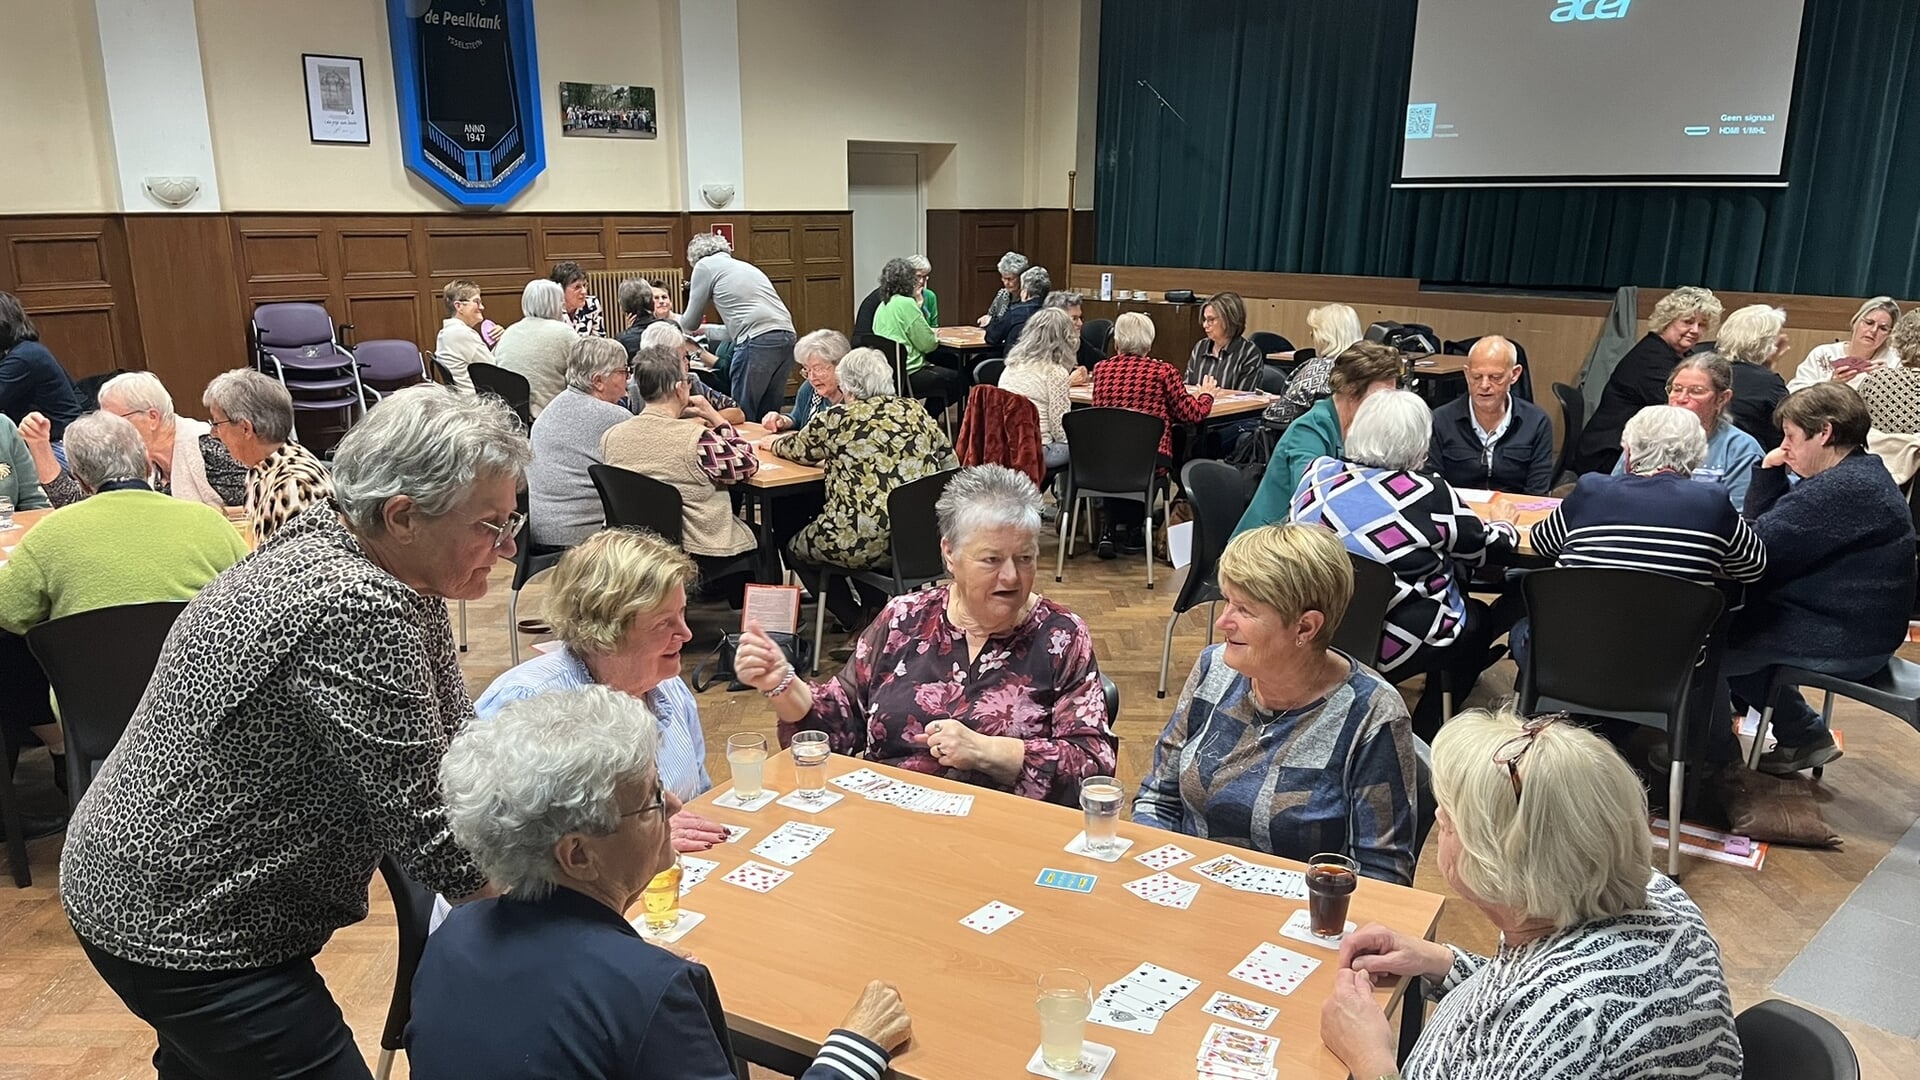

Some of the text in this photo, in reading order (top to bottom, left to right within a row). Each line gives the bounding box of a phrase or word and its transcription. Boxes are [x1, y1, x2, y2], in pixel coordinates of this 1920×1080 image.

[1550, 0, 1632, 22] acer
[424, 9, 501, 30] de Peelklank
[1720, 113, 1775, 123] Geen signaal
[464, 124, 486, 133] ANNO
[1719, 126, 1740, 135] HDMI
[466, 133, 486, 142] 1947
